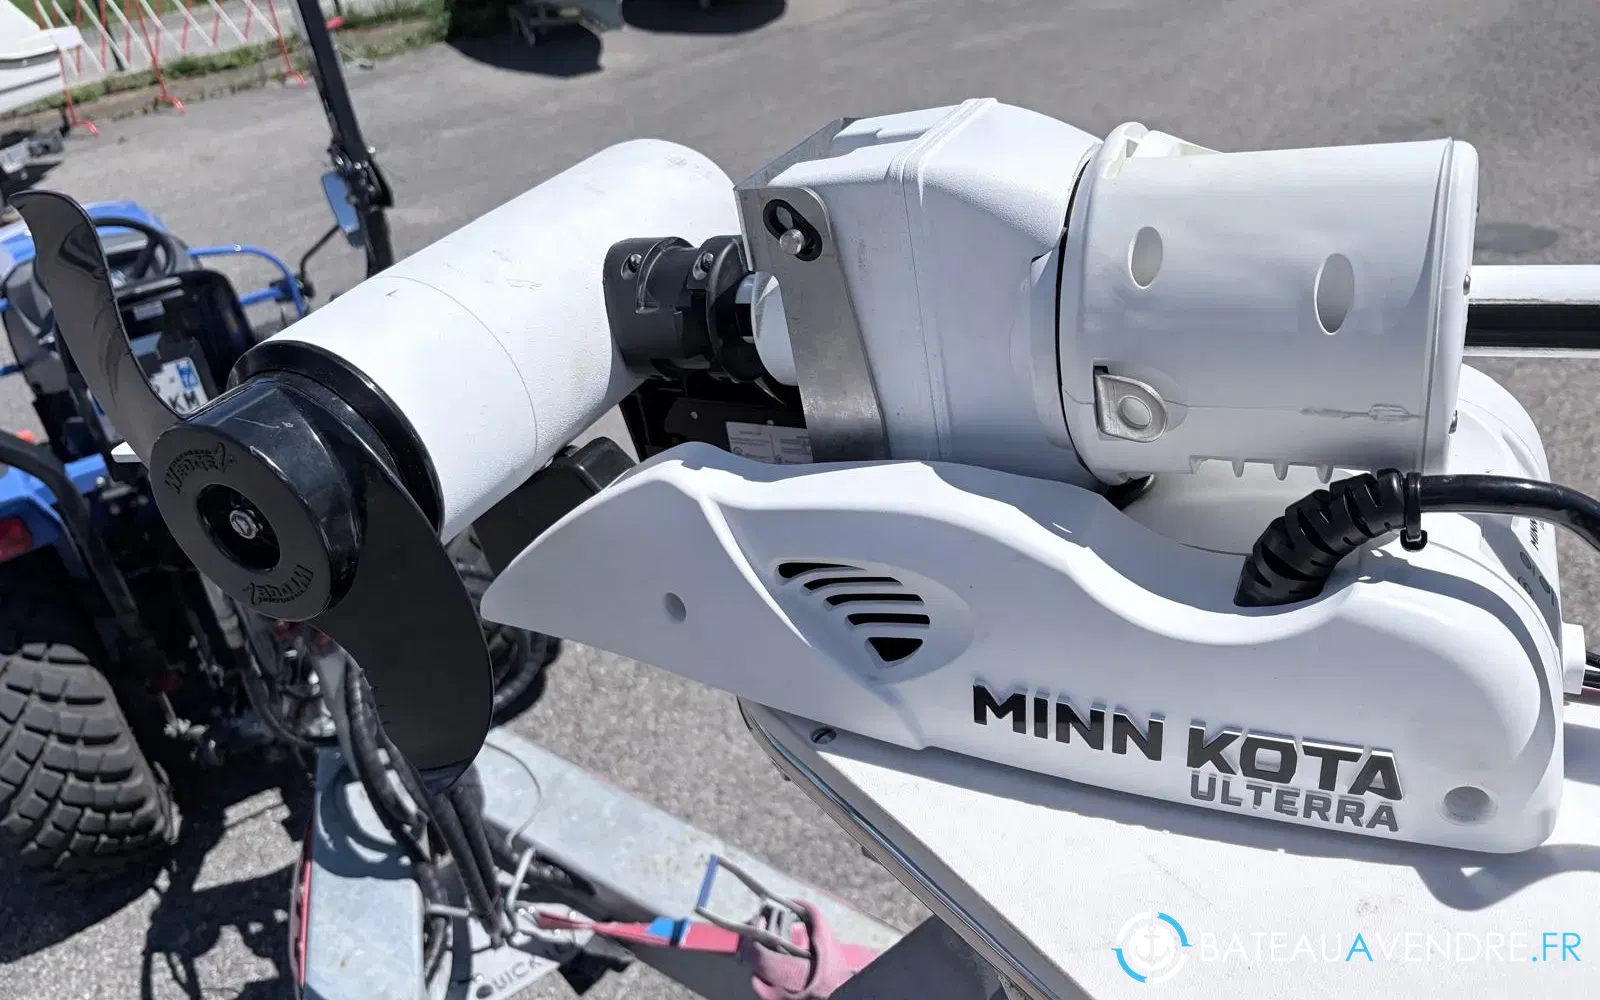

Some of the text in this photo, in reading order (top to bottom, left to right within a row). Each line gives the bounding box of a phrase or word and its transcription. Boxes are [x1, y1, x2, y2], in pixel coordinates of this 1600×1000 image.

[972, 680, 1404, 801] MINN KOTA
[1190, 772, 1399, 832] ULTERRA
